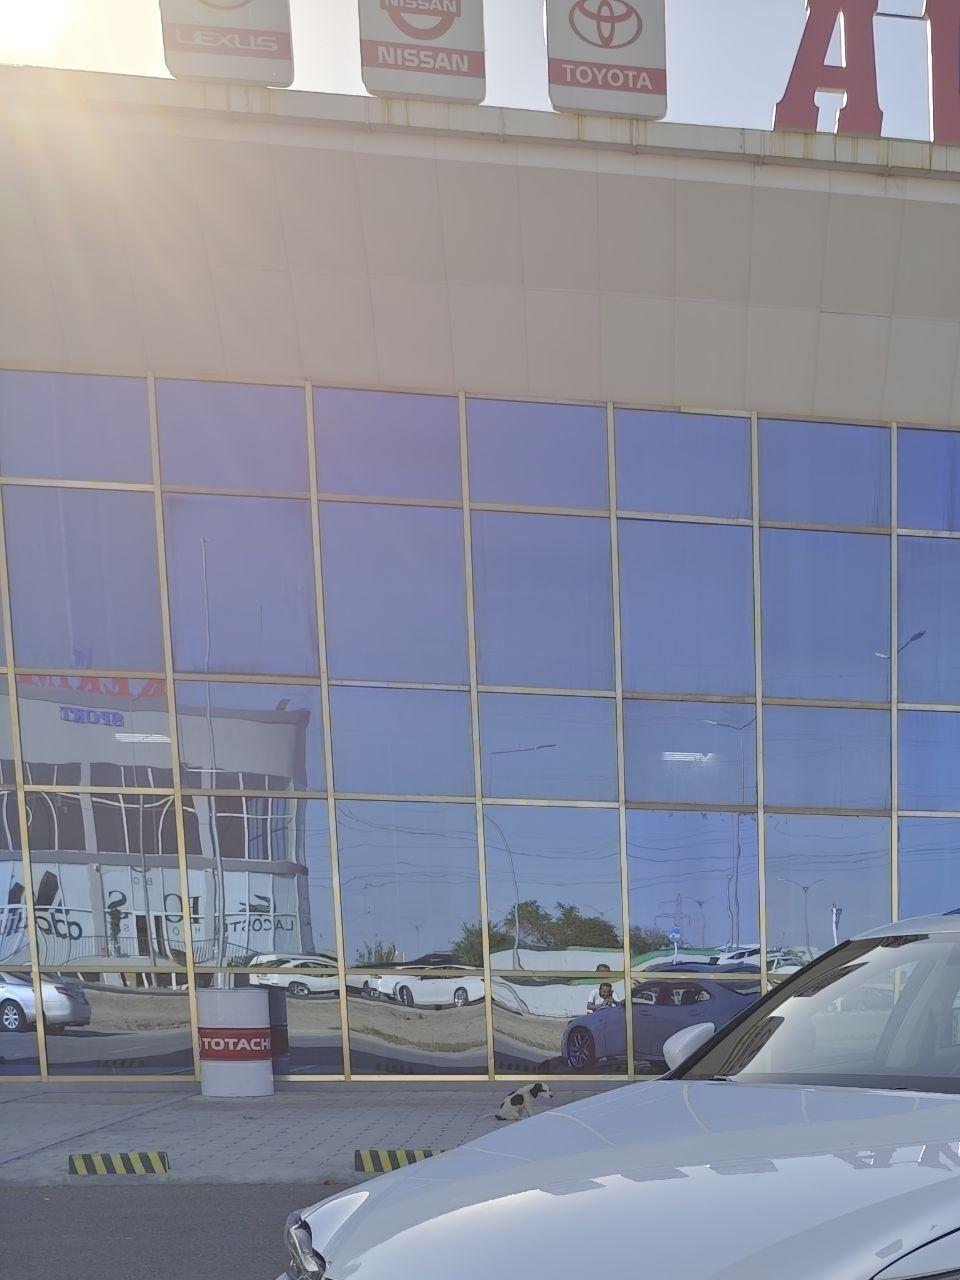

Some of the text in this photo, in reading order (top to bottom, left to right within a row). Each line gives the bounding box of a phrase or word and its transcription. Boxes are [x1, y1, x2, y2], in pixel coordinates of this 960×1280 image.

[175, 28, 280, 51] LEXUS
[376, 46, 469, 72] NISSAN
[561, 63, 653, 90] TOYOTA
